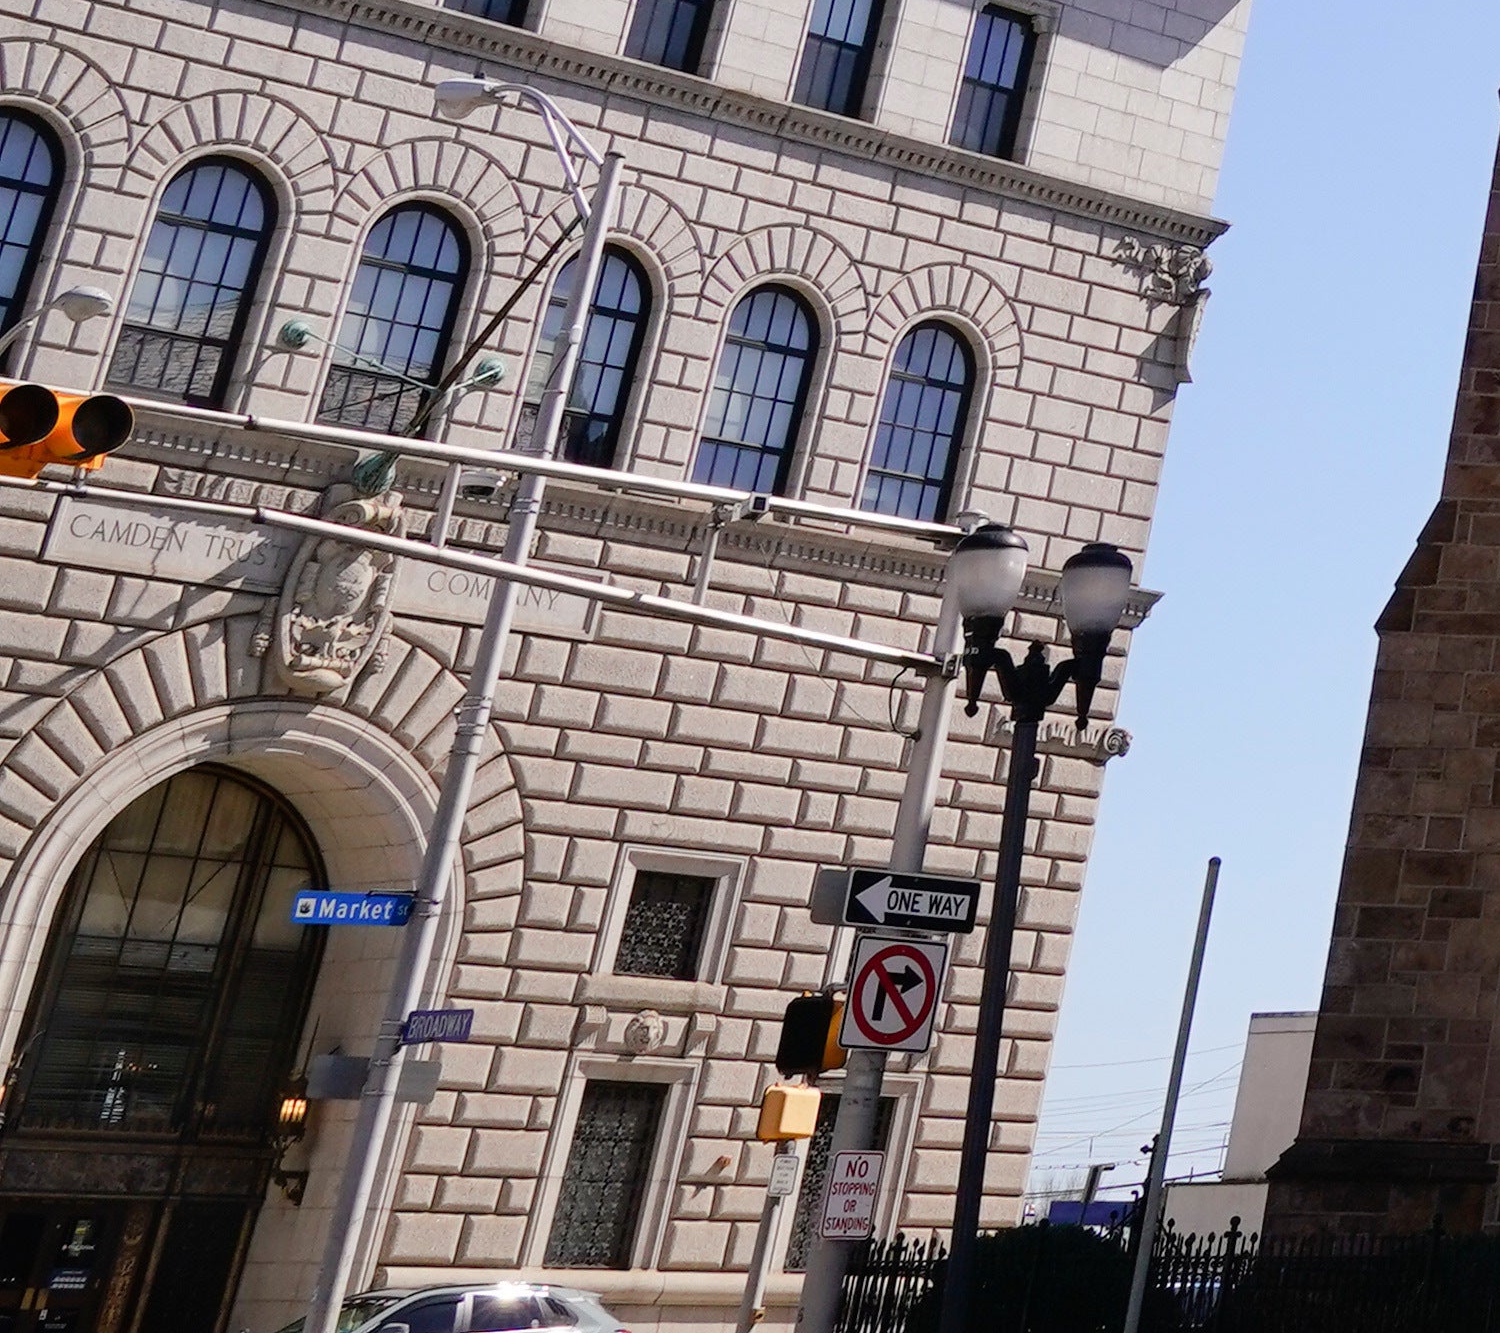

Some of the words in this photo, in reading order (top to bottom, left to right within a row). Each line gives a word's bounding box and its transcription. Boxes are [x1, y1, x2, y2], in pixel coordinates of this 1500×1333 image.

[70, 514, 187, 552] CAMDEN
[205, 533, 290, 569] TRUST
[427, 570, 563, 611] COMNY
[318, 897, 393, 920] Market
[887, 890, 923, 913] ONE
[928, 895, 965, 917] WAY
[407, 1016, 470, 1038] BROADWAY
[845, 1160, 869, 1178] NO
[831, 1181, 876, 1195] STOPPING
[843, 1199, 857, 1212] OR
[825, 1216, 870, 1230] STANDING
